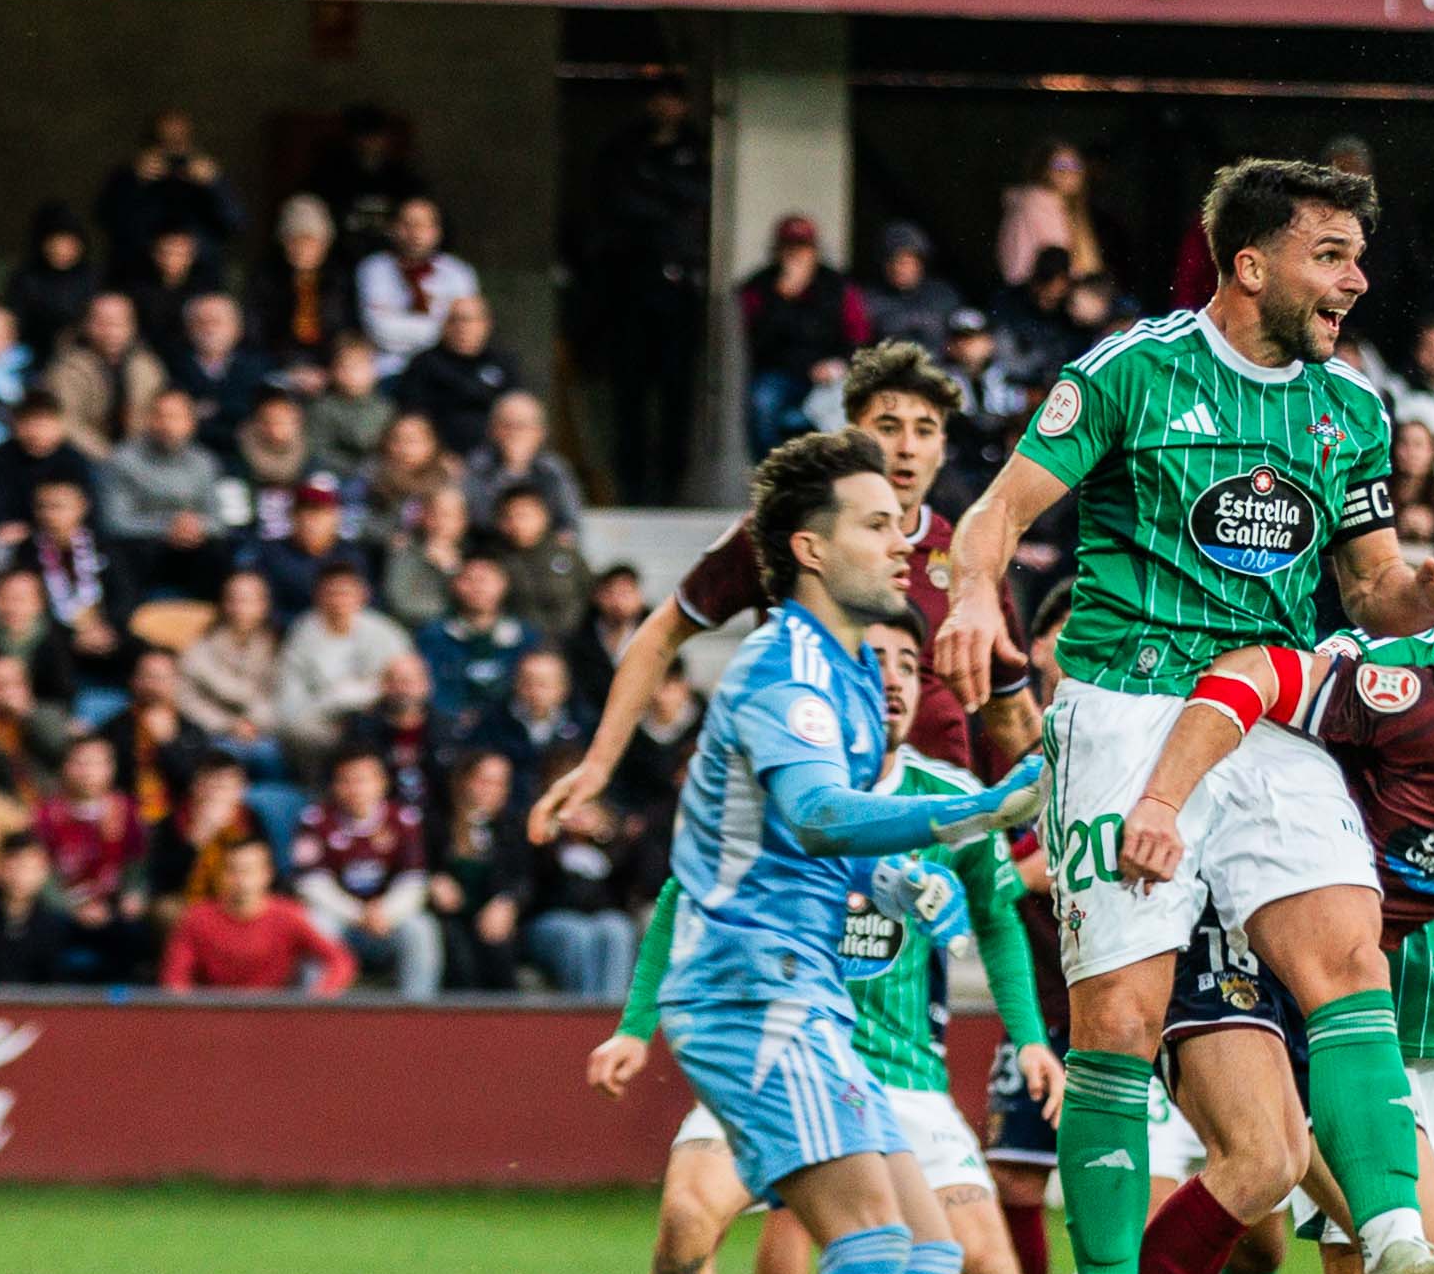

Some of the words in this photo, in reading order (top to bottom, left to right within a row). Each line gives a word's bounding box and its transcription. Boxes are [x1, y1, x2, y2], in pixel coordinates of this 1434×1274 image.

[1214, 491, 1301, 525] Estrella
[1371, 481, 1395, 518] C
[1216, 517, 1293, 549] Galicia
[1066, 812, 1125, 893] 20
[845, 913, 895, 937] rella
[838, 934, 890, 959] licia
